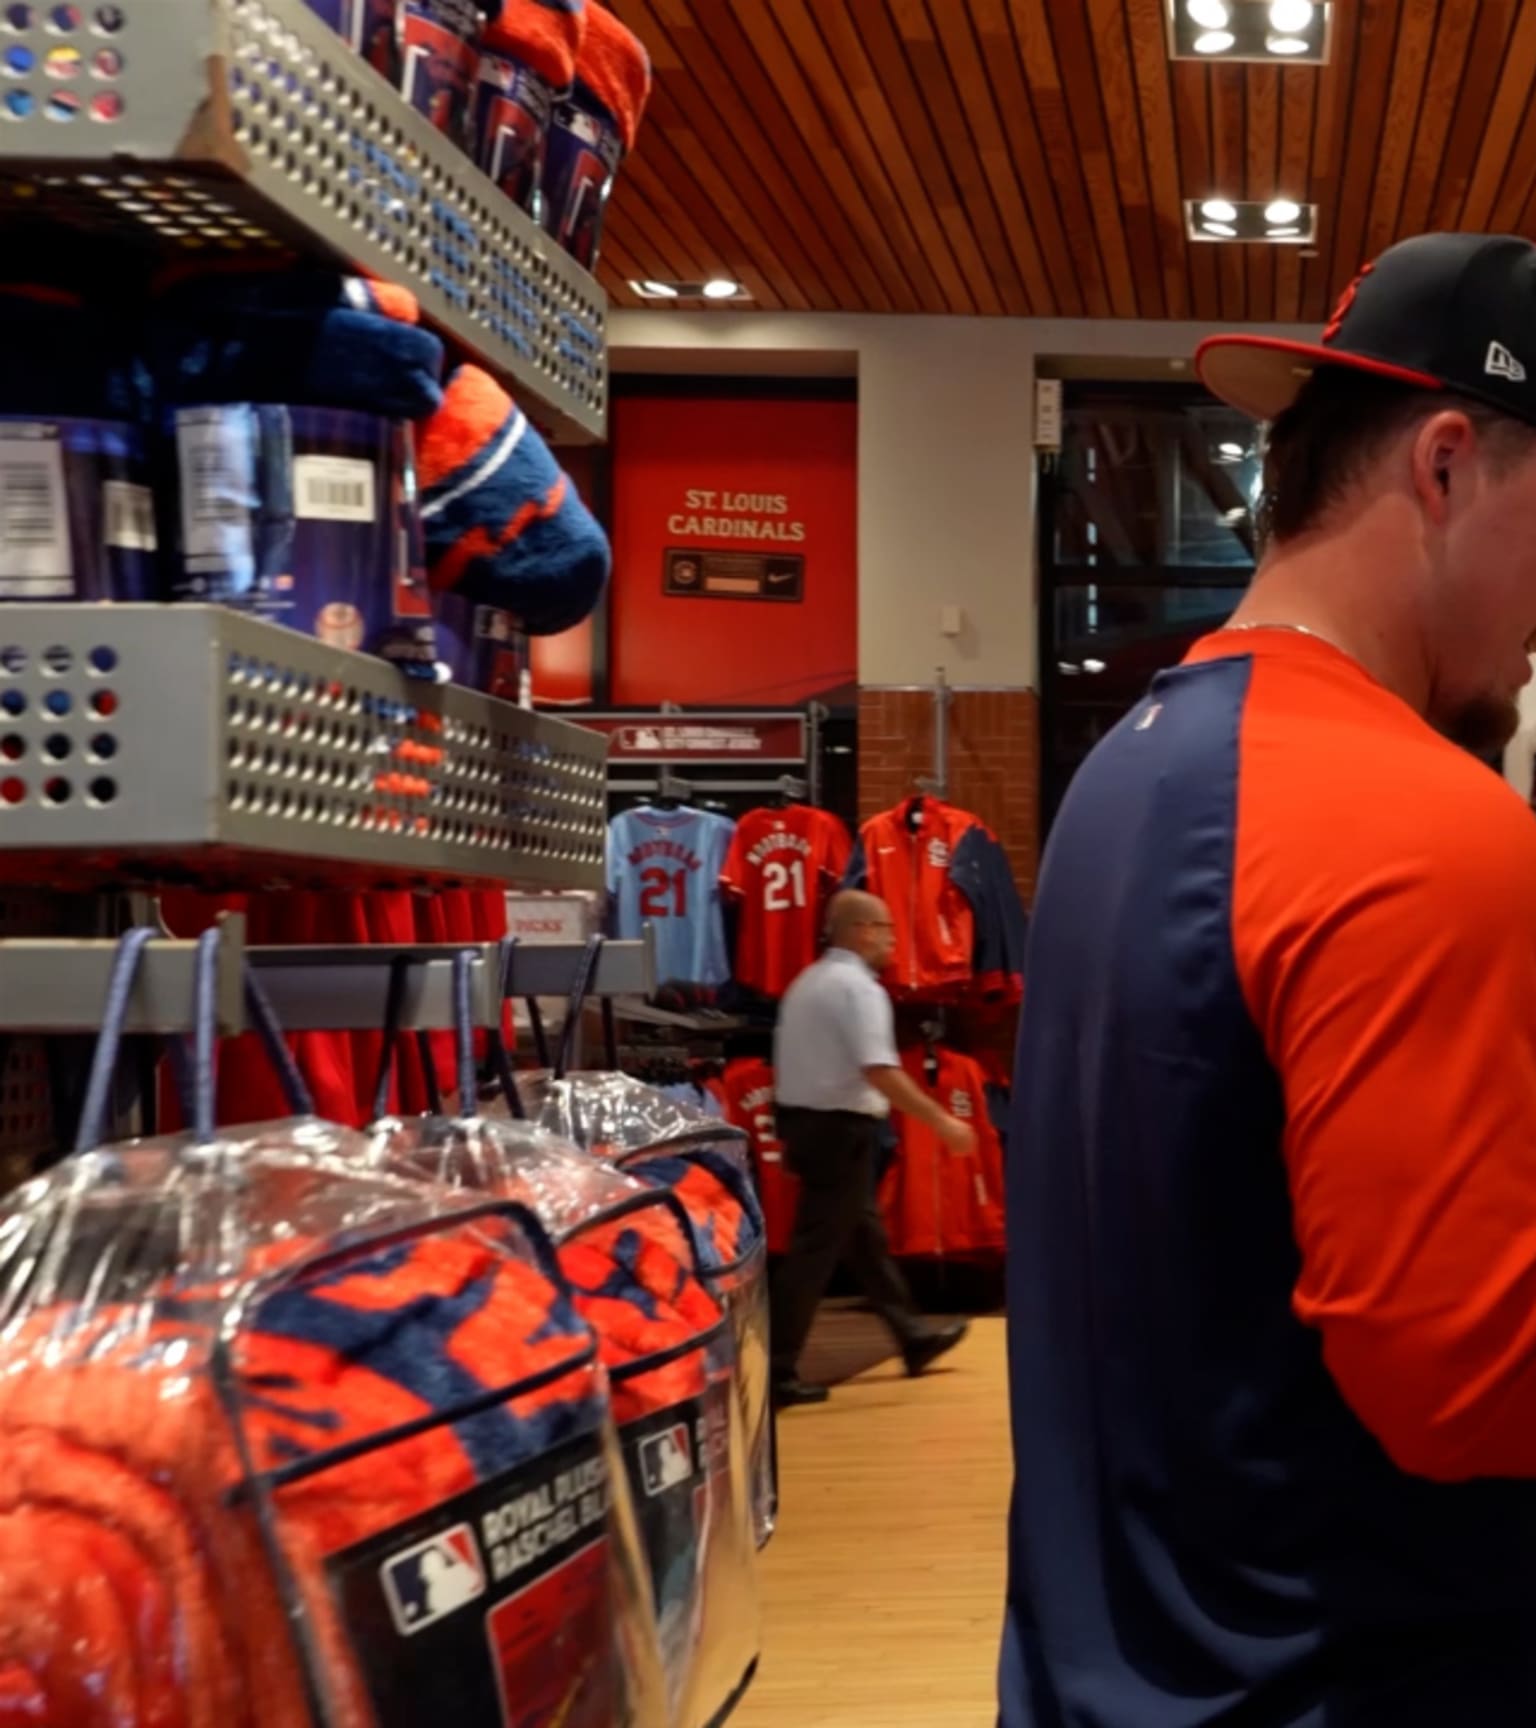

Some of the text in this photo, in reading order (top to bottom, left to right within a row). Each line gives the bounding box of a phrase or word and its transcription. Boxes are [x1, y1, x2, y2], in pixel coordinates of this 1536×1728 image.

[667, 515, 806, 541] CARDINALS
[722, 492, 788, 514] LOUIS
[640, 868, 687, 918] 21
[763, 860, 806, 911] 21
[482, 1484, 555, 1548] ROYAL
